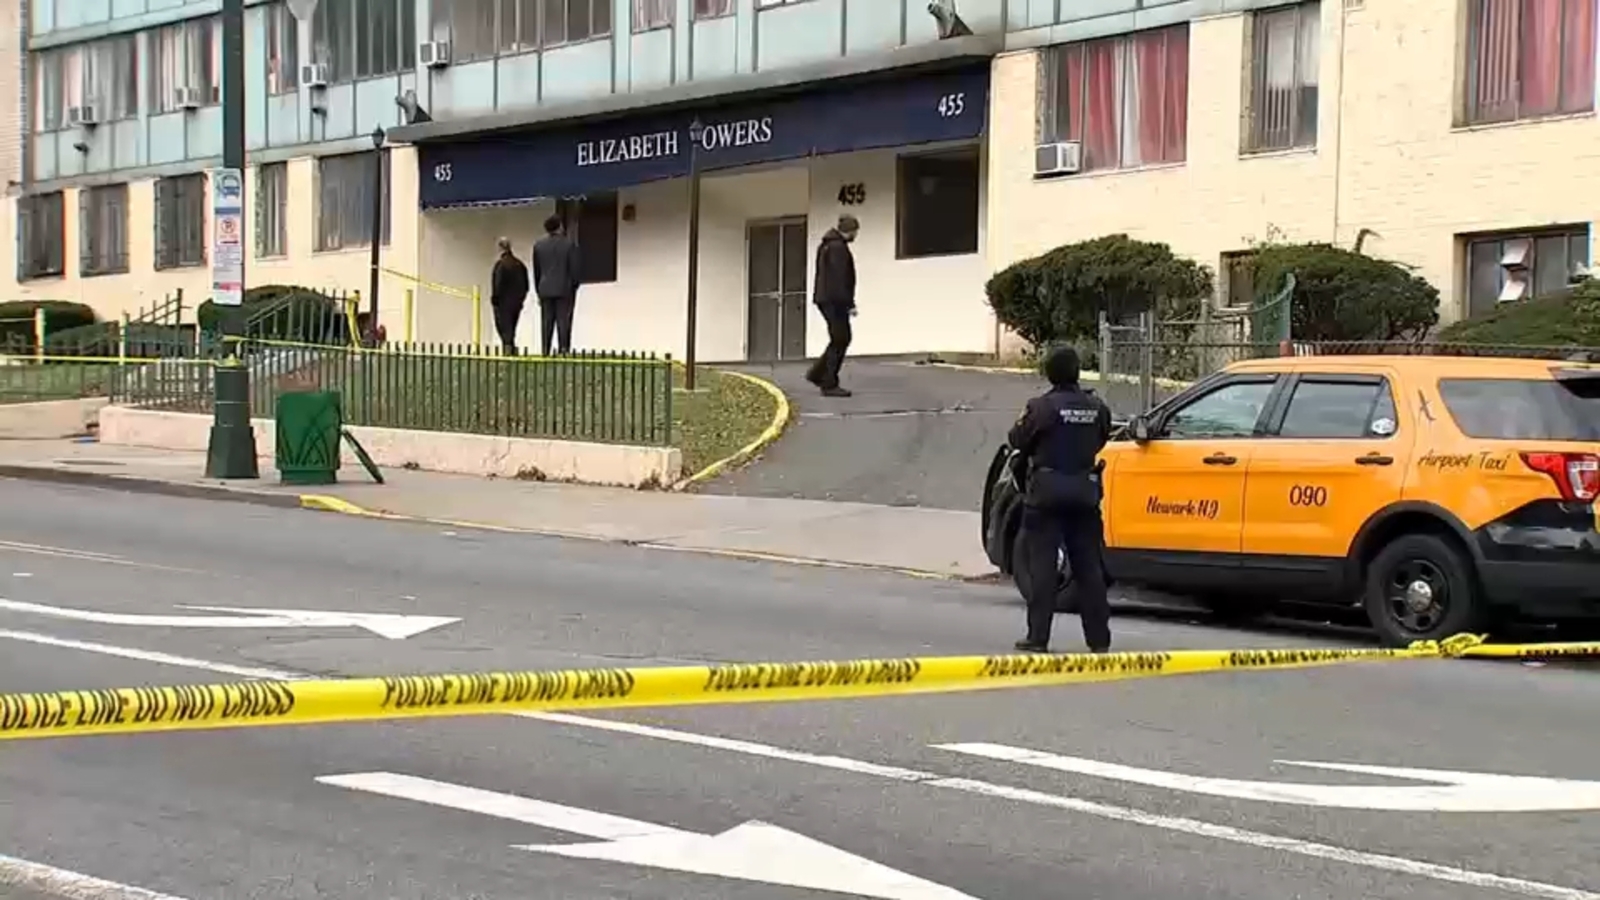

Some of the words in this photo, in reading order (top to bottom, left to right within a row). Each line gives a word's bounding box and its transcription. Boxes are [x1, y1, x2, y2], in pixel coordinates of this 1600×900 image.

[938, 93, 964, 117] 455
[577, 131, 678, 166] ELIZABETH
[690, 117, 773, 151] OWERS
[434, 163, 452, 181] 455
[838, 183, 866, 205] 455
[1064, 416, 1095, 424] POLICE
[1418, 450, 1474, 472] Airport
[1479, 451, 1511, 471] Taxi
[1147, 496, 1195, 514] Newark
[1289, 485, 1327, 507] 090
[703, 663, 767, 692] POLICE
[766, 662, 806, 687] LINE
[804, 659, 834, 687] DO
[381, 673, 453, 709] POLICE
[452, 671, 500, 705] LINE
[500, 670, 535, 703] DO
[534, 669, 571, 701] NOT
[570, 667, 635, 700] CROSS
[75, 688, 131, 725] LINE
[133, 685, 172, 723] DO
[171, 684, 216, 721] NOT
[219, 680, 295, 718] CROSS
